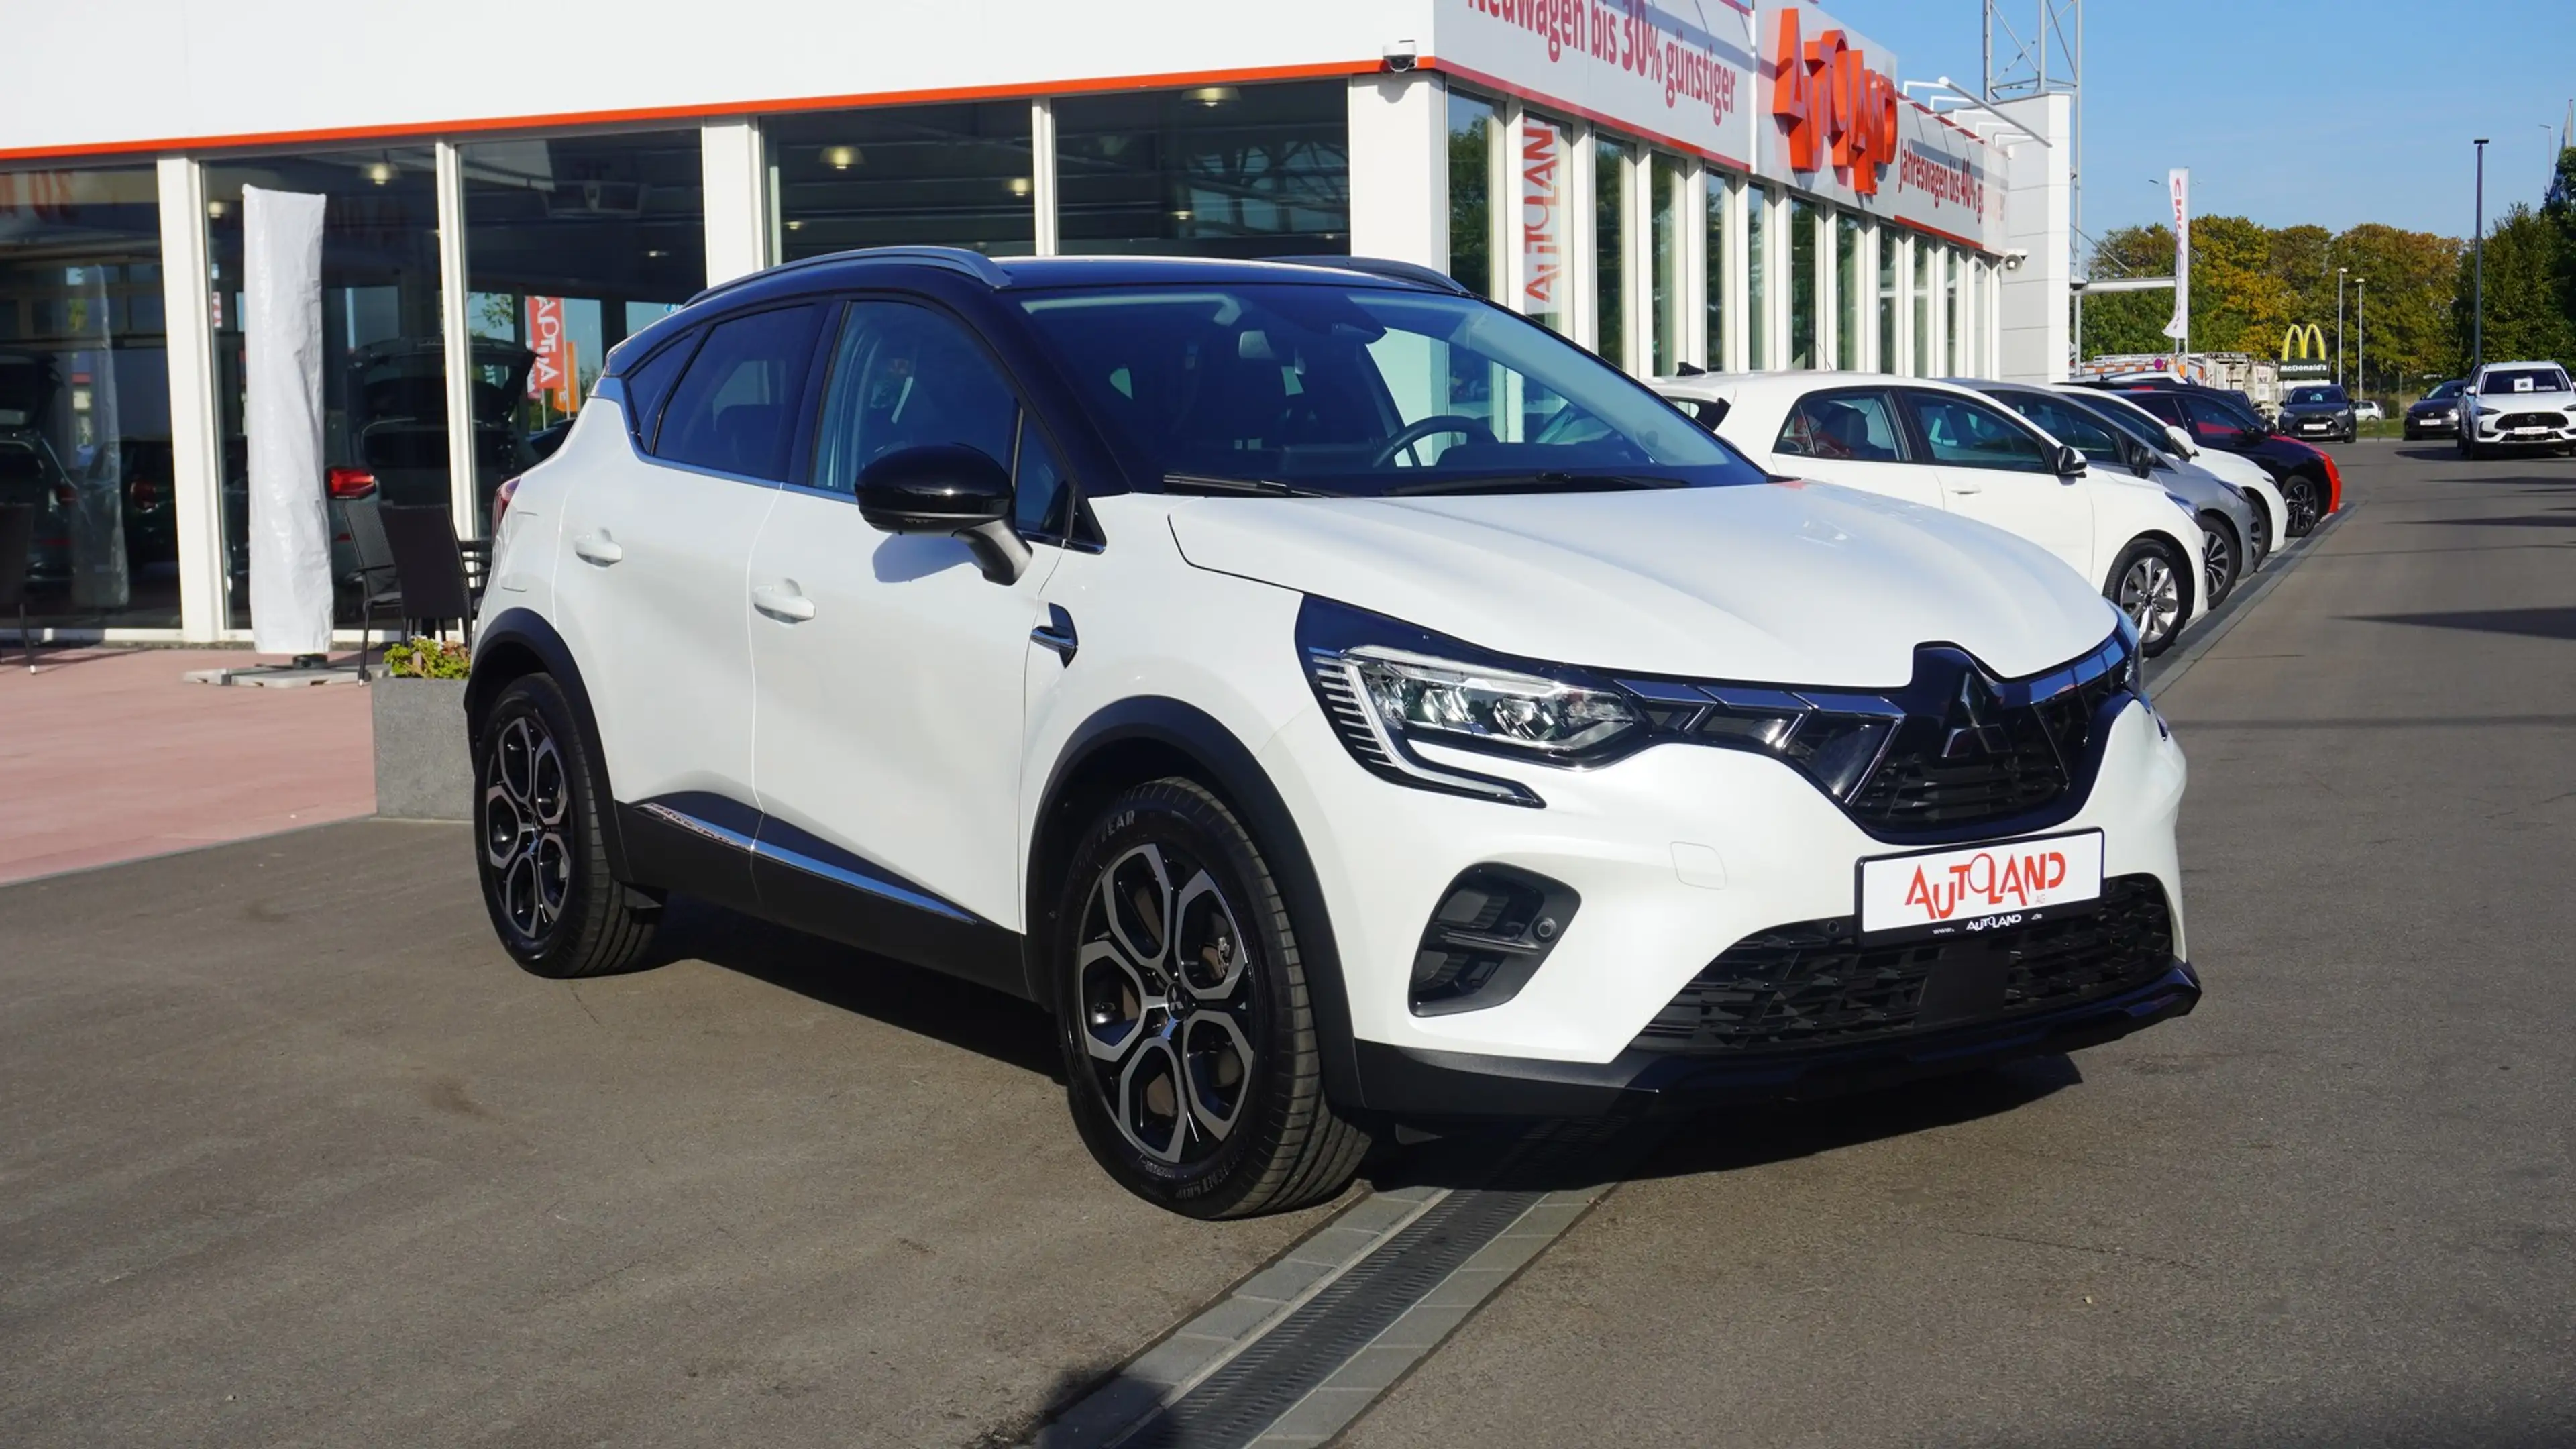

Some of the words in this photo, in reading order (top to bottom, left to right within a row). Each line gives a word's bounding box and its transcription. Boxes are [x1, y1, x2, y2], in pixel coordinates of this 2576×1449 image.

[1468, 0, 1585, 62] uwagen
[1591, 0, 1617, 64] bis
[1622, 0, 1662, 83] 30%
[1666, 28, 1735, 126] günstiger
[1897, 138, 1948, 209] Jahreswagen
[1523, 117, 1560, 303] AUTOLAN
[2279, 364, 2328, 372] McDonald's
[1905, 853, 2065, 920] AUTOLAND
[2035, 894, 2046, 904] AG
[1966, 914, 2021, 931] AUTOLAND
